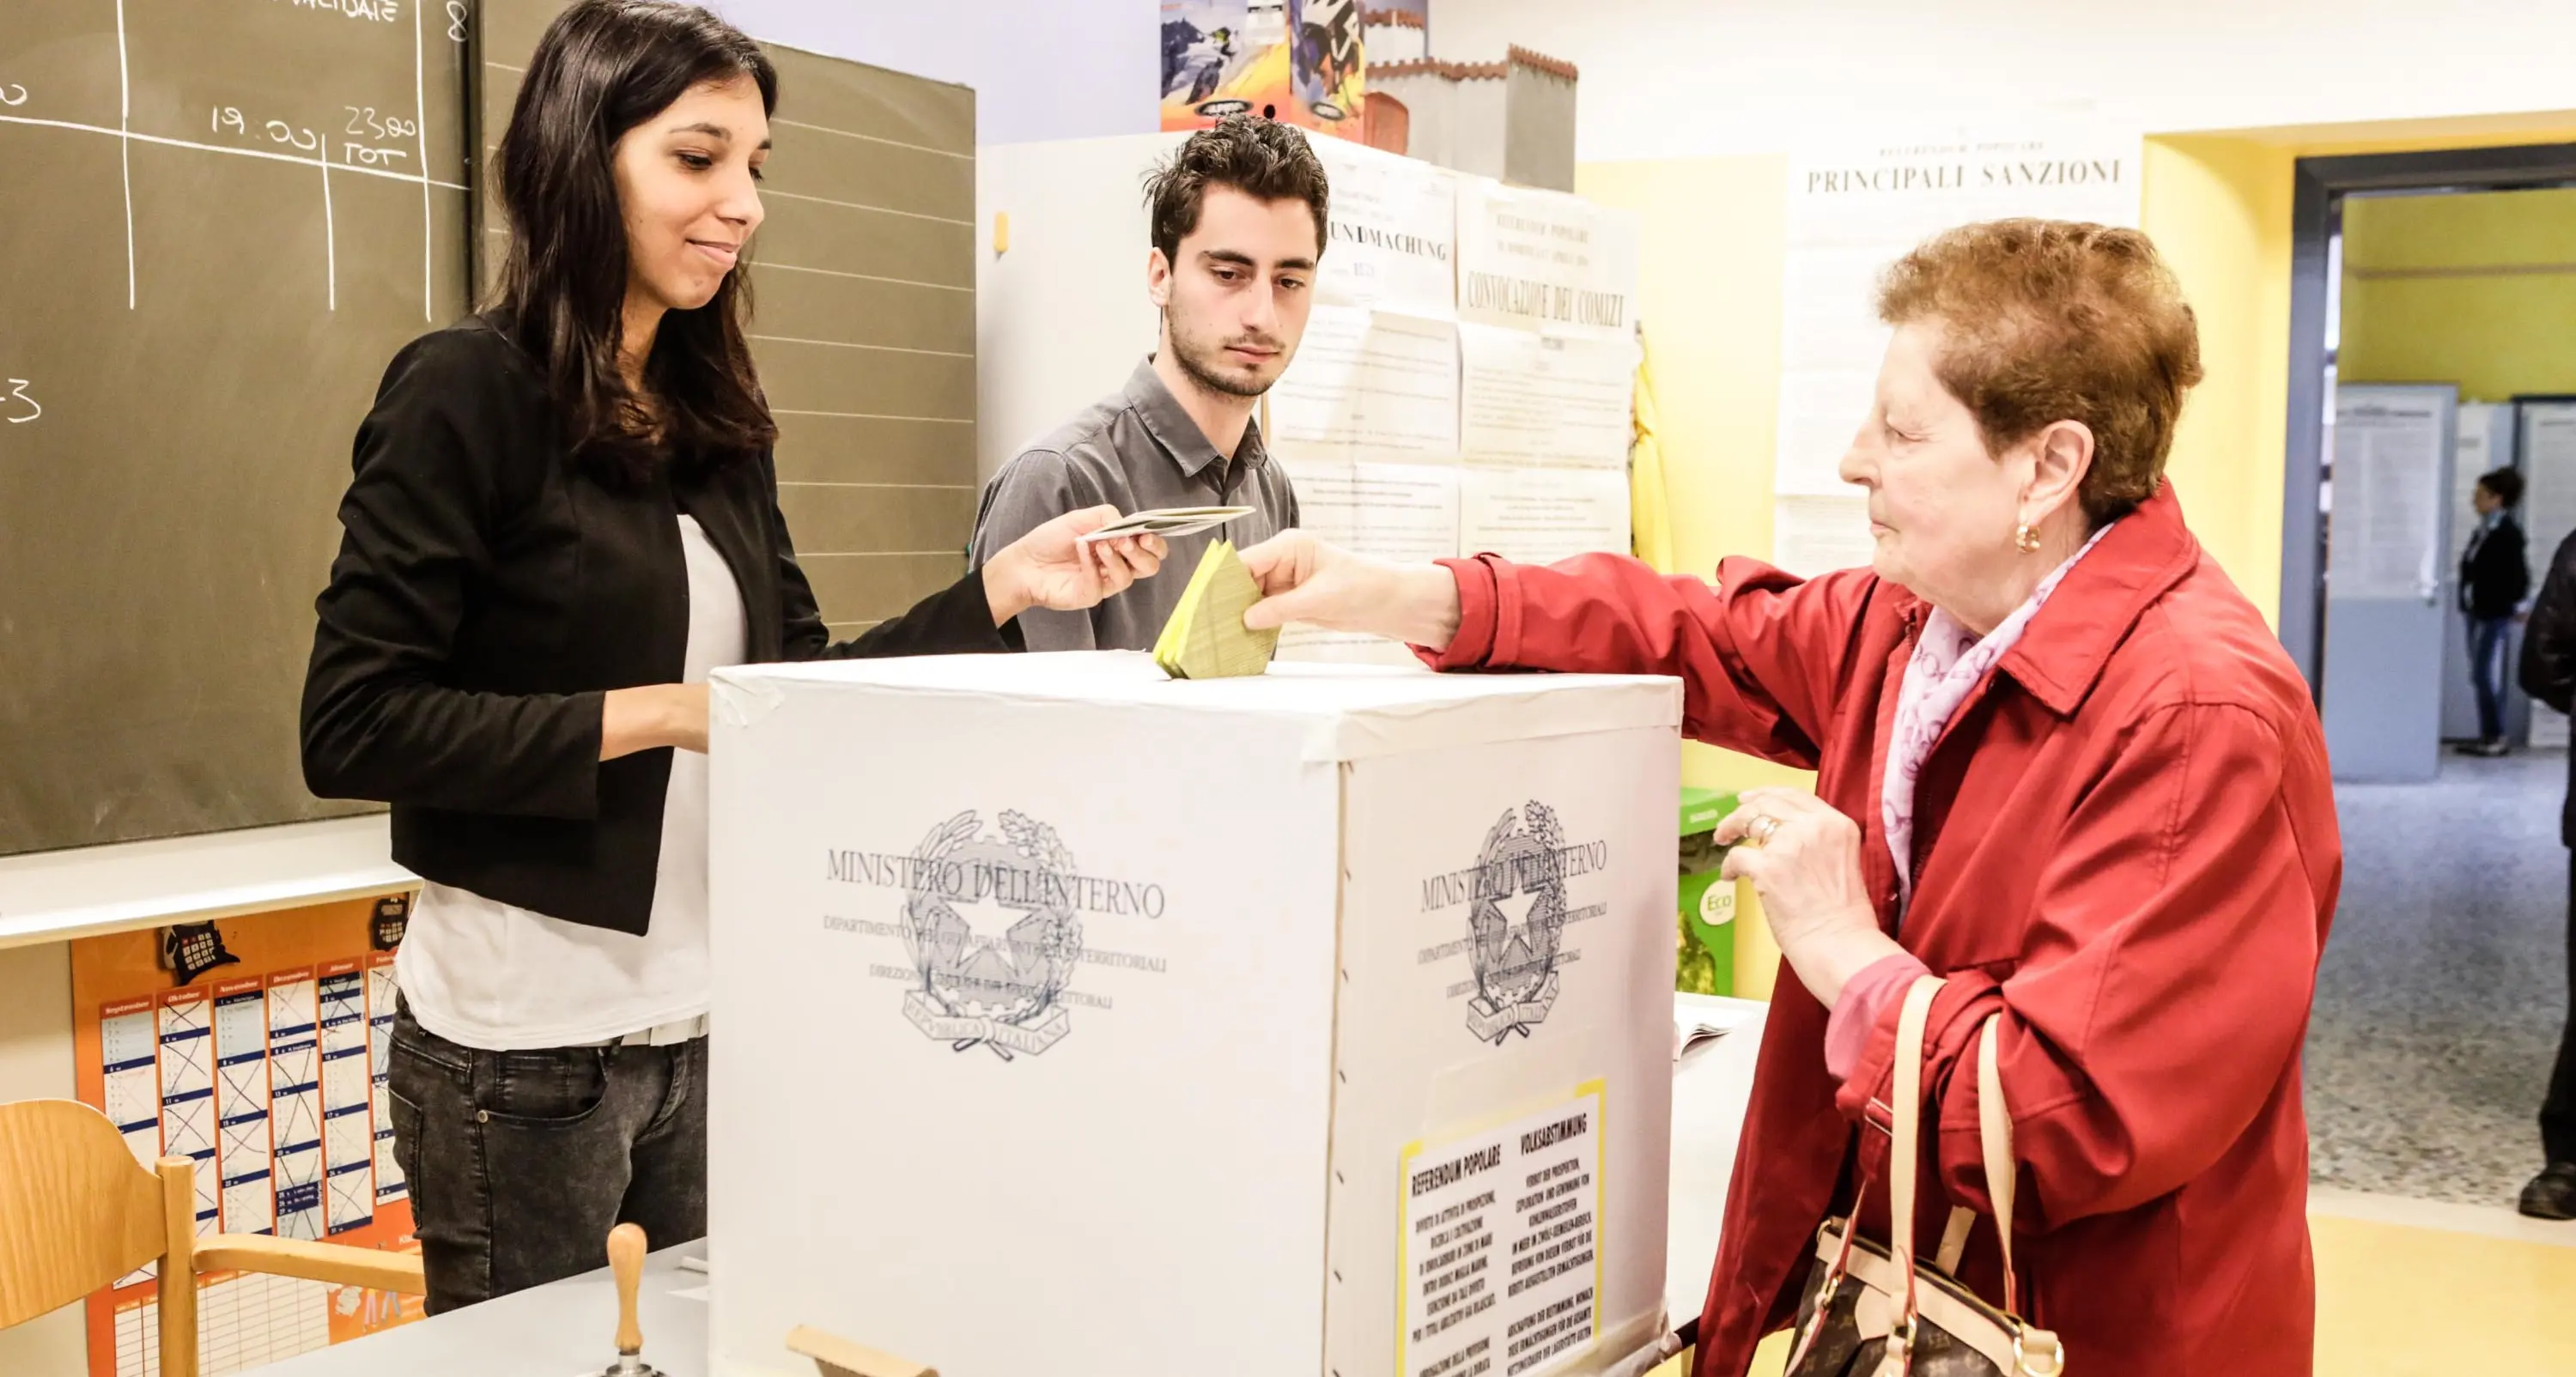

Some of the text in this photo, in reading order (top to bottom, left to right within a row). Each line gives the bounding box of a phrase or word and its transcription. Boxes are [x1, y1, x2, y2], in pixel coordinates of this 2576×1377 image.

[344, 143, 407, 165] TOT
[1807, 158, 2120, 194] PRINCIPALI SANZIONI
[1330, 221, 1447, 261] UNDMACHUNG
[1577, 288, 1625, 328] COMIZI
[827, 848, 1166, 919] MINISTERO DELL'INTERNO
[1707, 894, 1732, 912] Eco
[220, 979, 258, 993] November
[273, 971, 310, 983] Dezember
[167, 991, 201, 1003] Oktober
[1521, 1113, 1587, 1156] VOLKSABSTIMMUNG
[1412, 1143, 1501, 1198] REFERENDUM POPOLARE
